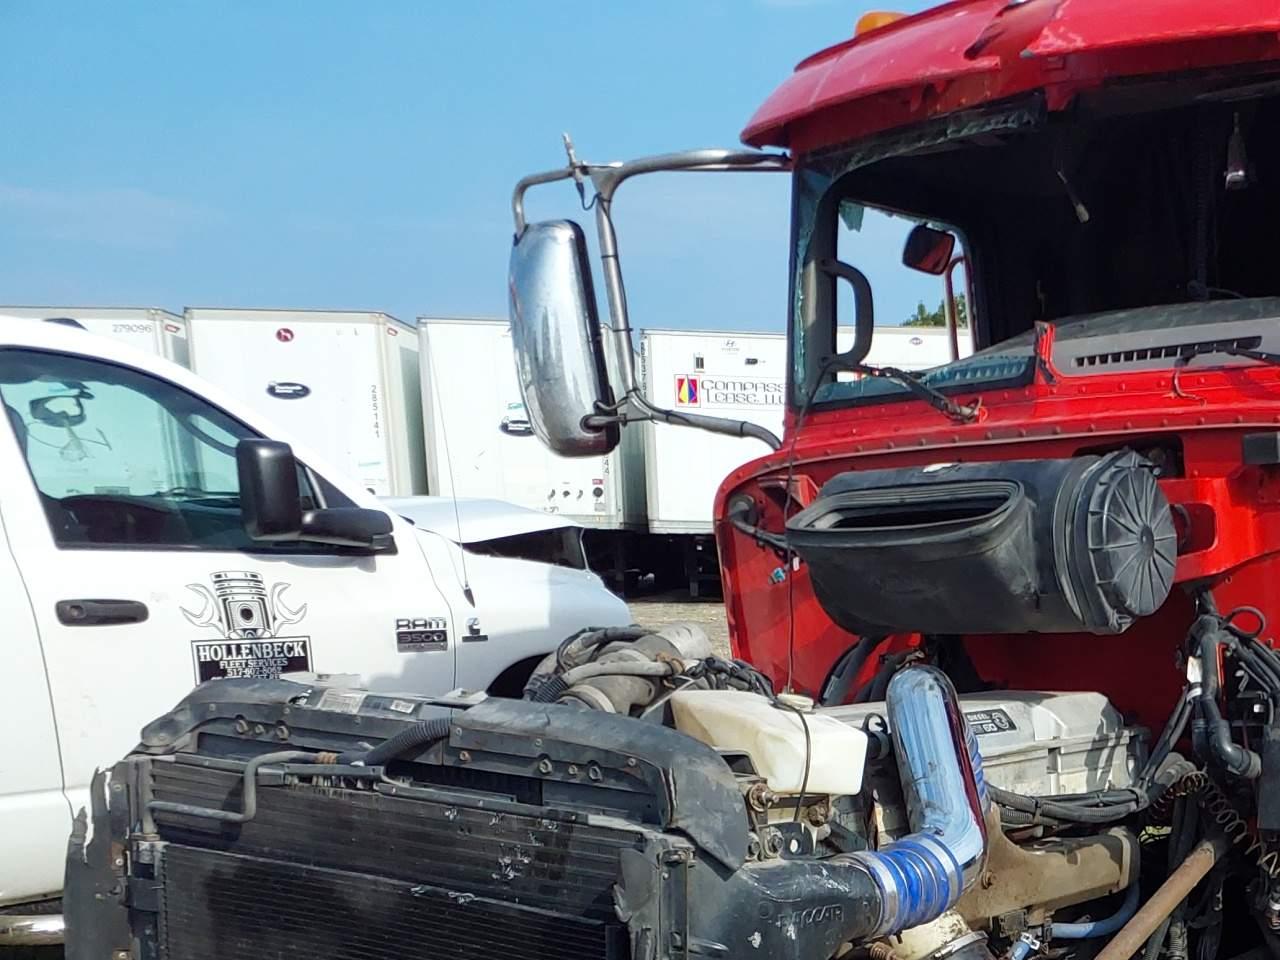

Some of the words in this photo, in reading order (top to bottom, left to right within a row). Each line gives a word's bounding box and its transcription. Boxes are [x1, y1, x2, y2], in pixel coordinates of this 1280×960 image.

[396, 618, 447, 630] RAM
[398, 632, 444, 643] 3500
[198, 641, 306, 662] HOLLENBECK
[220, 660, 246, 669] FLEET
[247, 657, 288, 668] SERVICES
